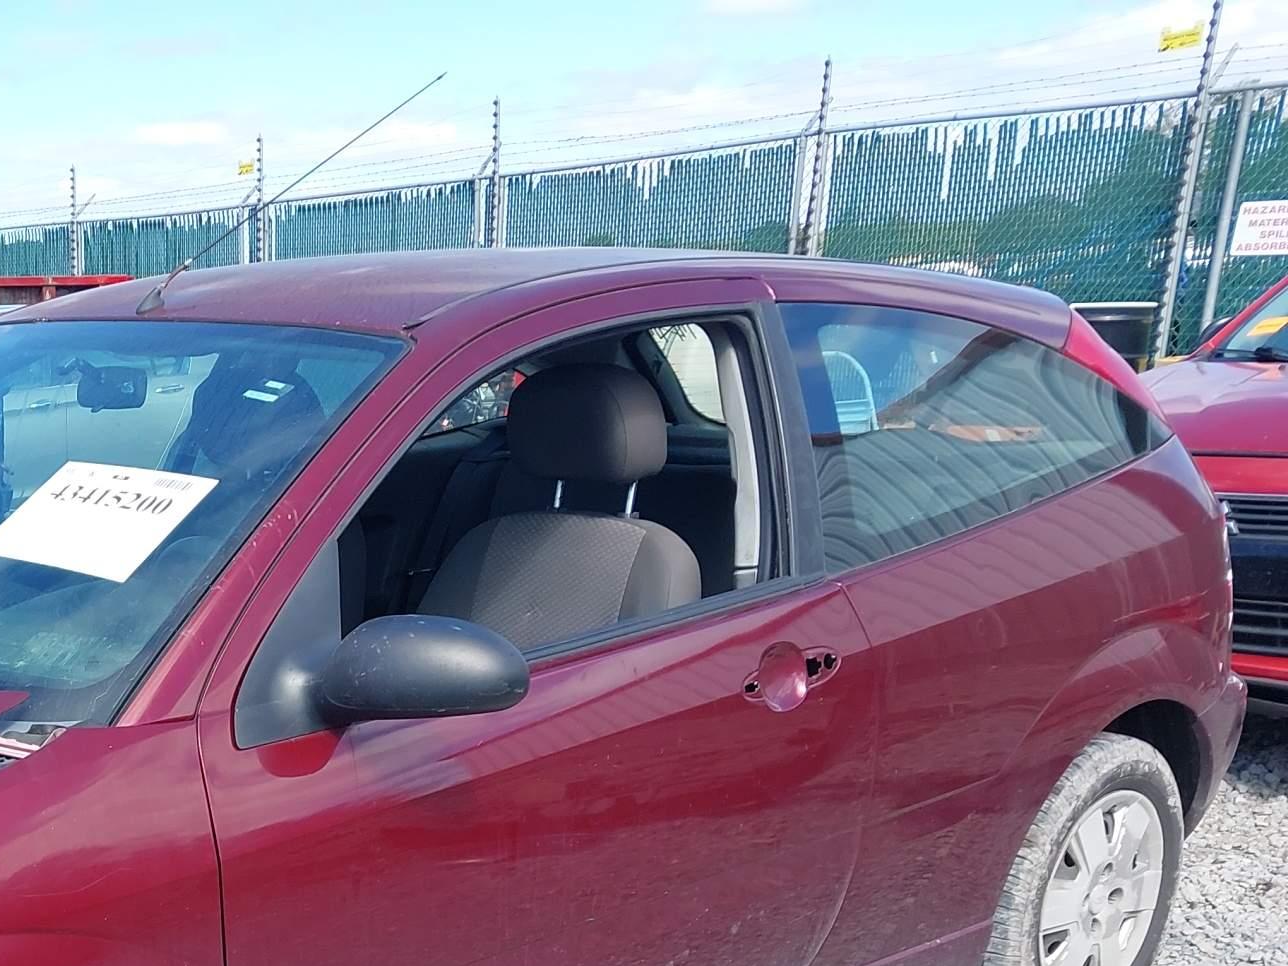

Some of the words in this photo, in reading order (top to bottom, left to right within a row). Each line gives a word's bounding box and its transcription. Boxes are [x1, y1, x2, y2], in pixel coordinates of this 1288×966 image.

[1242, 205, 1288, 215] HAZAR
[1258, 229, 1288, 239] SPIL
[1235, 242, 1288, 252] ABSORB
[50, 483, 174, 515] 43415200
